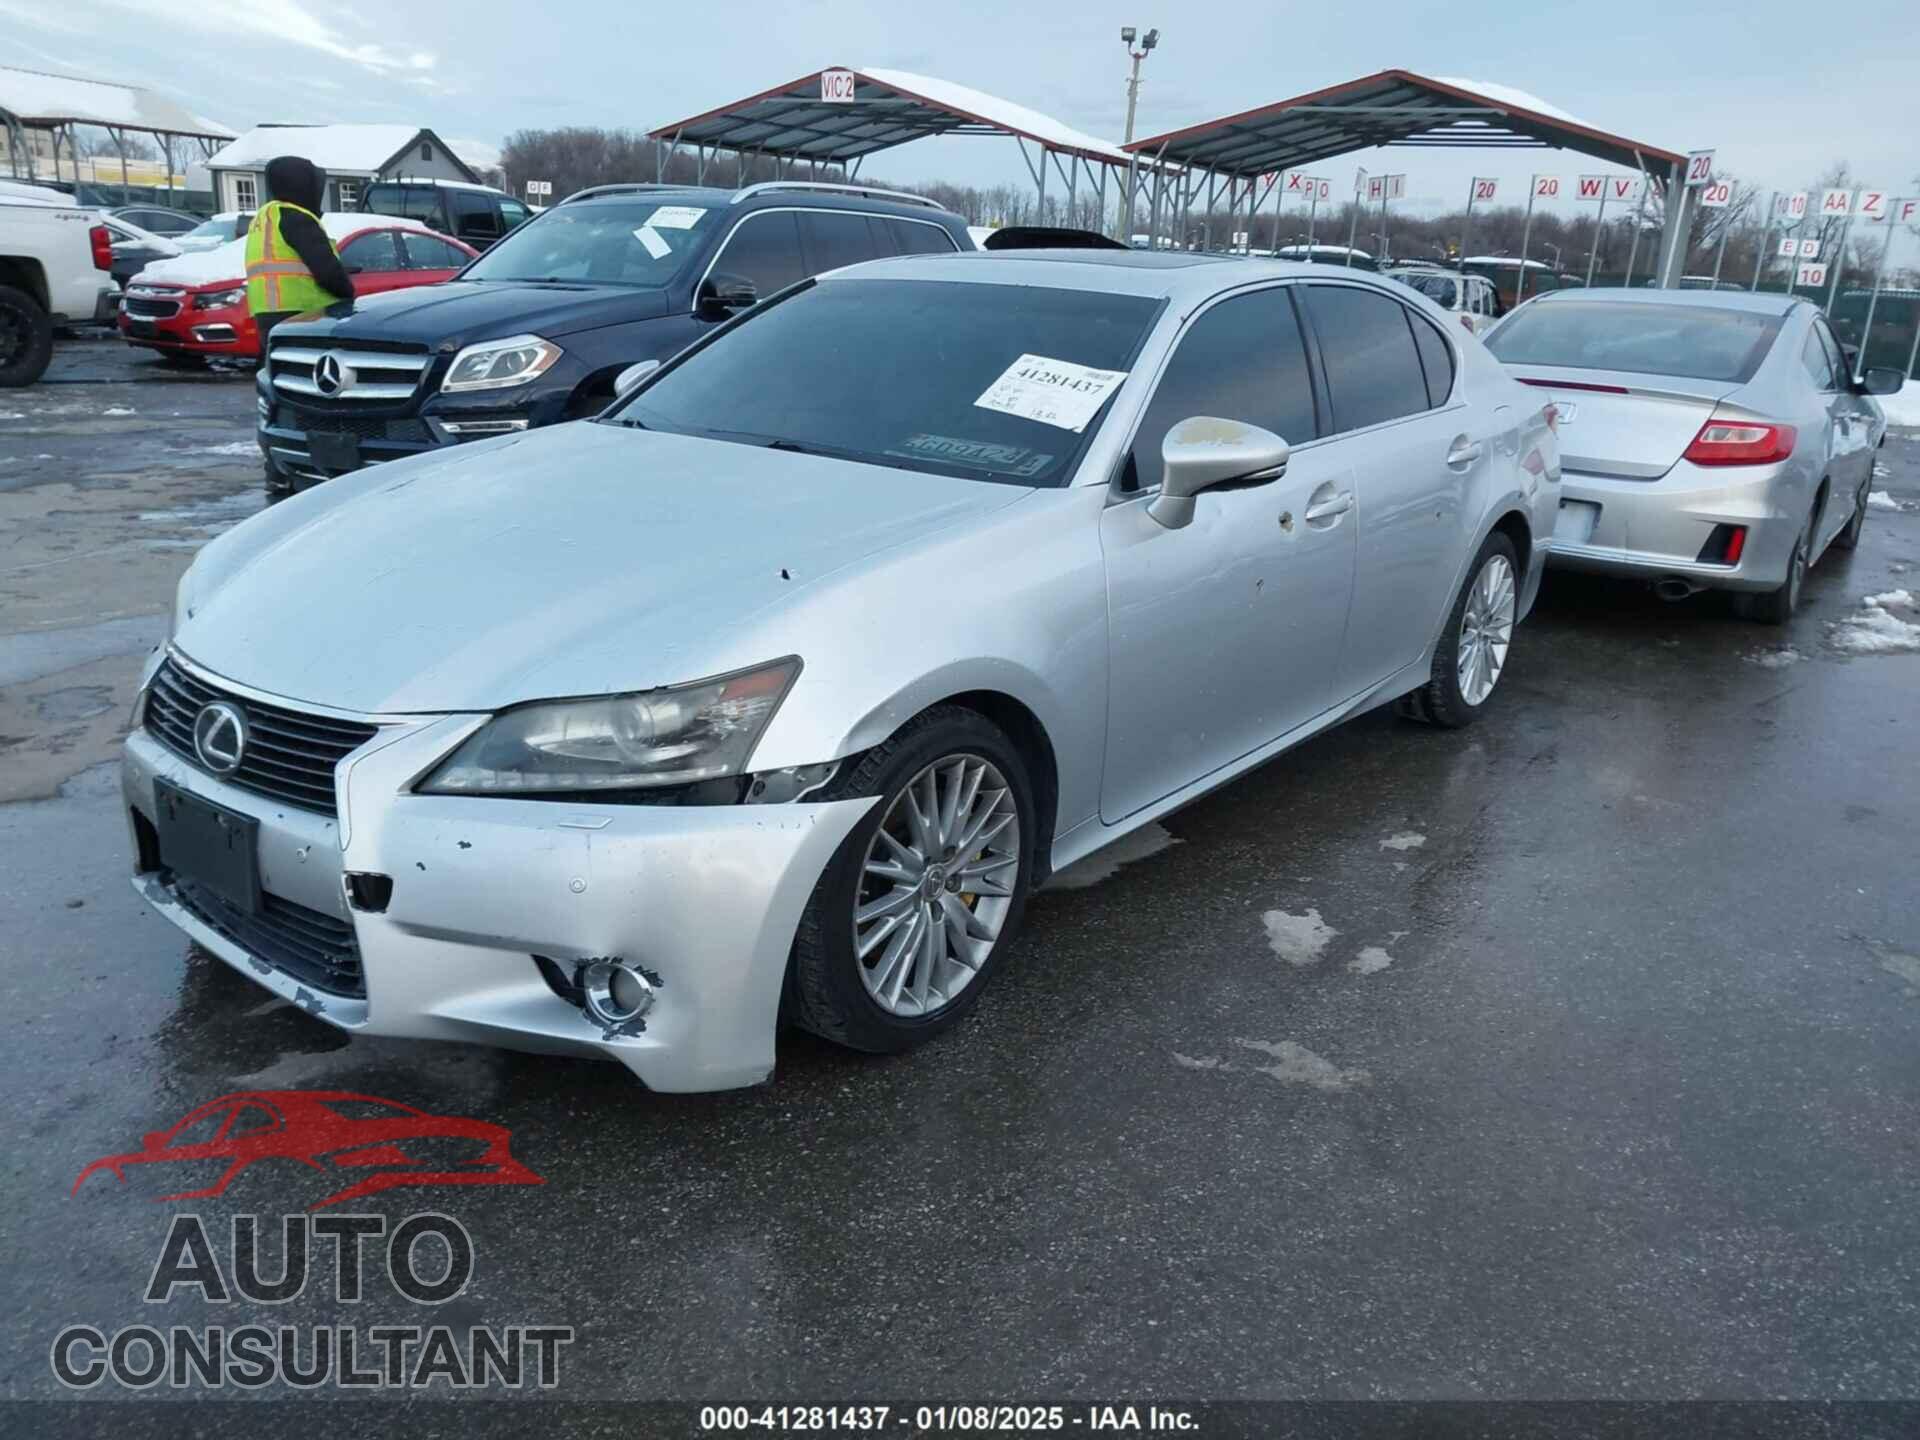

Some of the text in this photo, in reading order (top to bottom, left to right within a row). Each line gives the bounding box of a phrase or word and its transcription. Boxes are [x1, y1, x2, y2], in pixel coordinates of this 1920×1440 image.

[822, 74, 854, 99] VIC 2
[1690, 156, 1712, 181] 20
[1288, 174, 1302, 189] X
[1371, 179, 1382, 196] H
[1477, 181, 1496, 198] 20
[1536, 178, 1560, 196] 20
[1580, 179, 1601, 197] W
[1615, 180, 1630, 198] V
[1705, 184, 1729, 202] 20
[1824, 192, 1847, 211] AA
[1791, 195, 1805, 214] 10
[1863, 194, 1881, 212] Z
[1902, 202, 1916, 221] F
[1783, 241, 1793, 253] E
[1804, 241, 1815, 255] D
[1801, 269, 1823, 284] 10
[1017, 367, 1105, 396] 41281437
